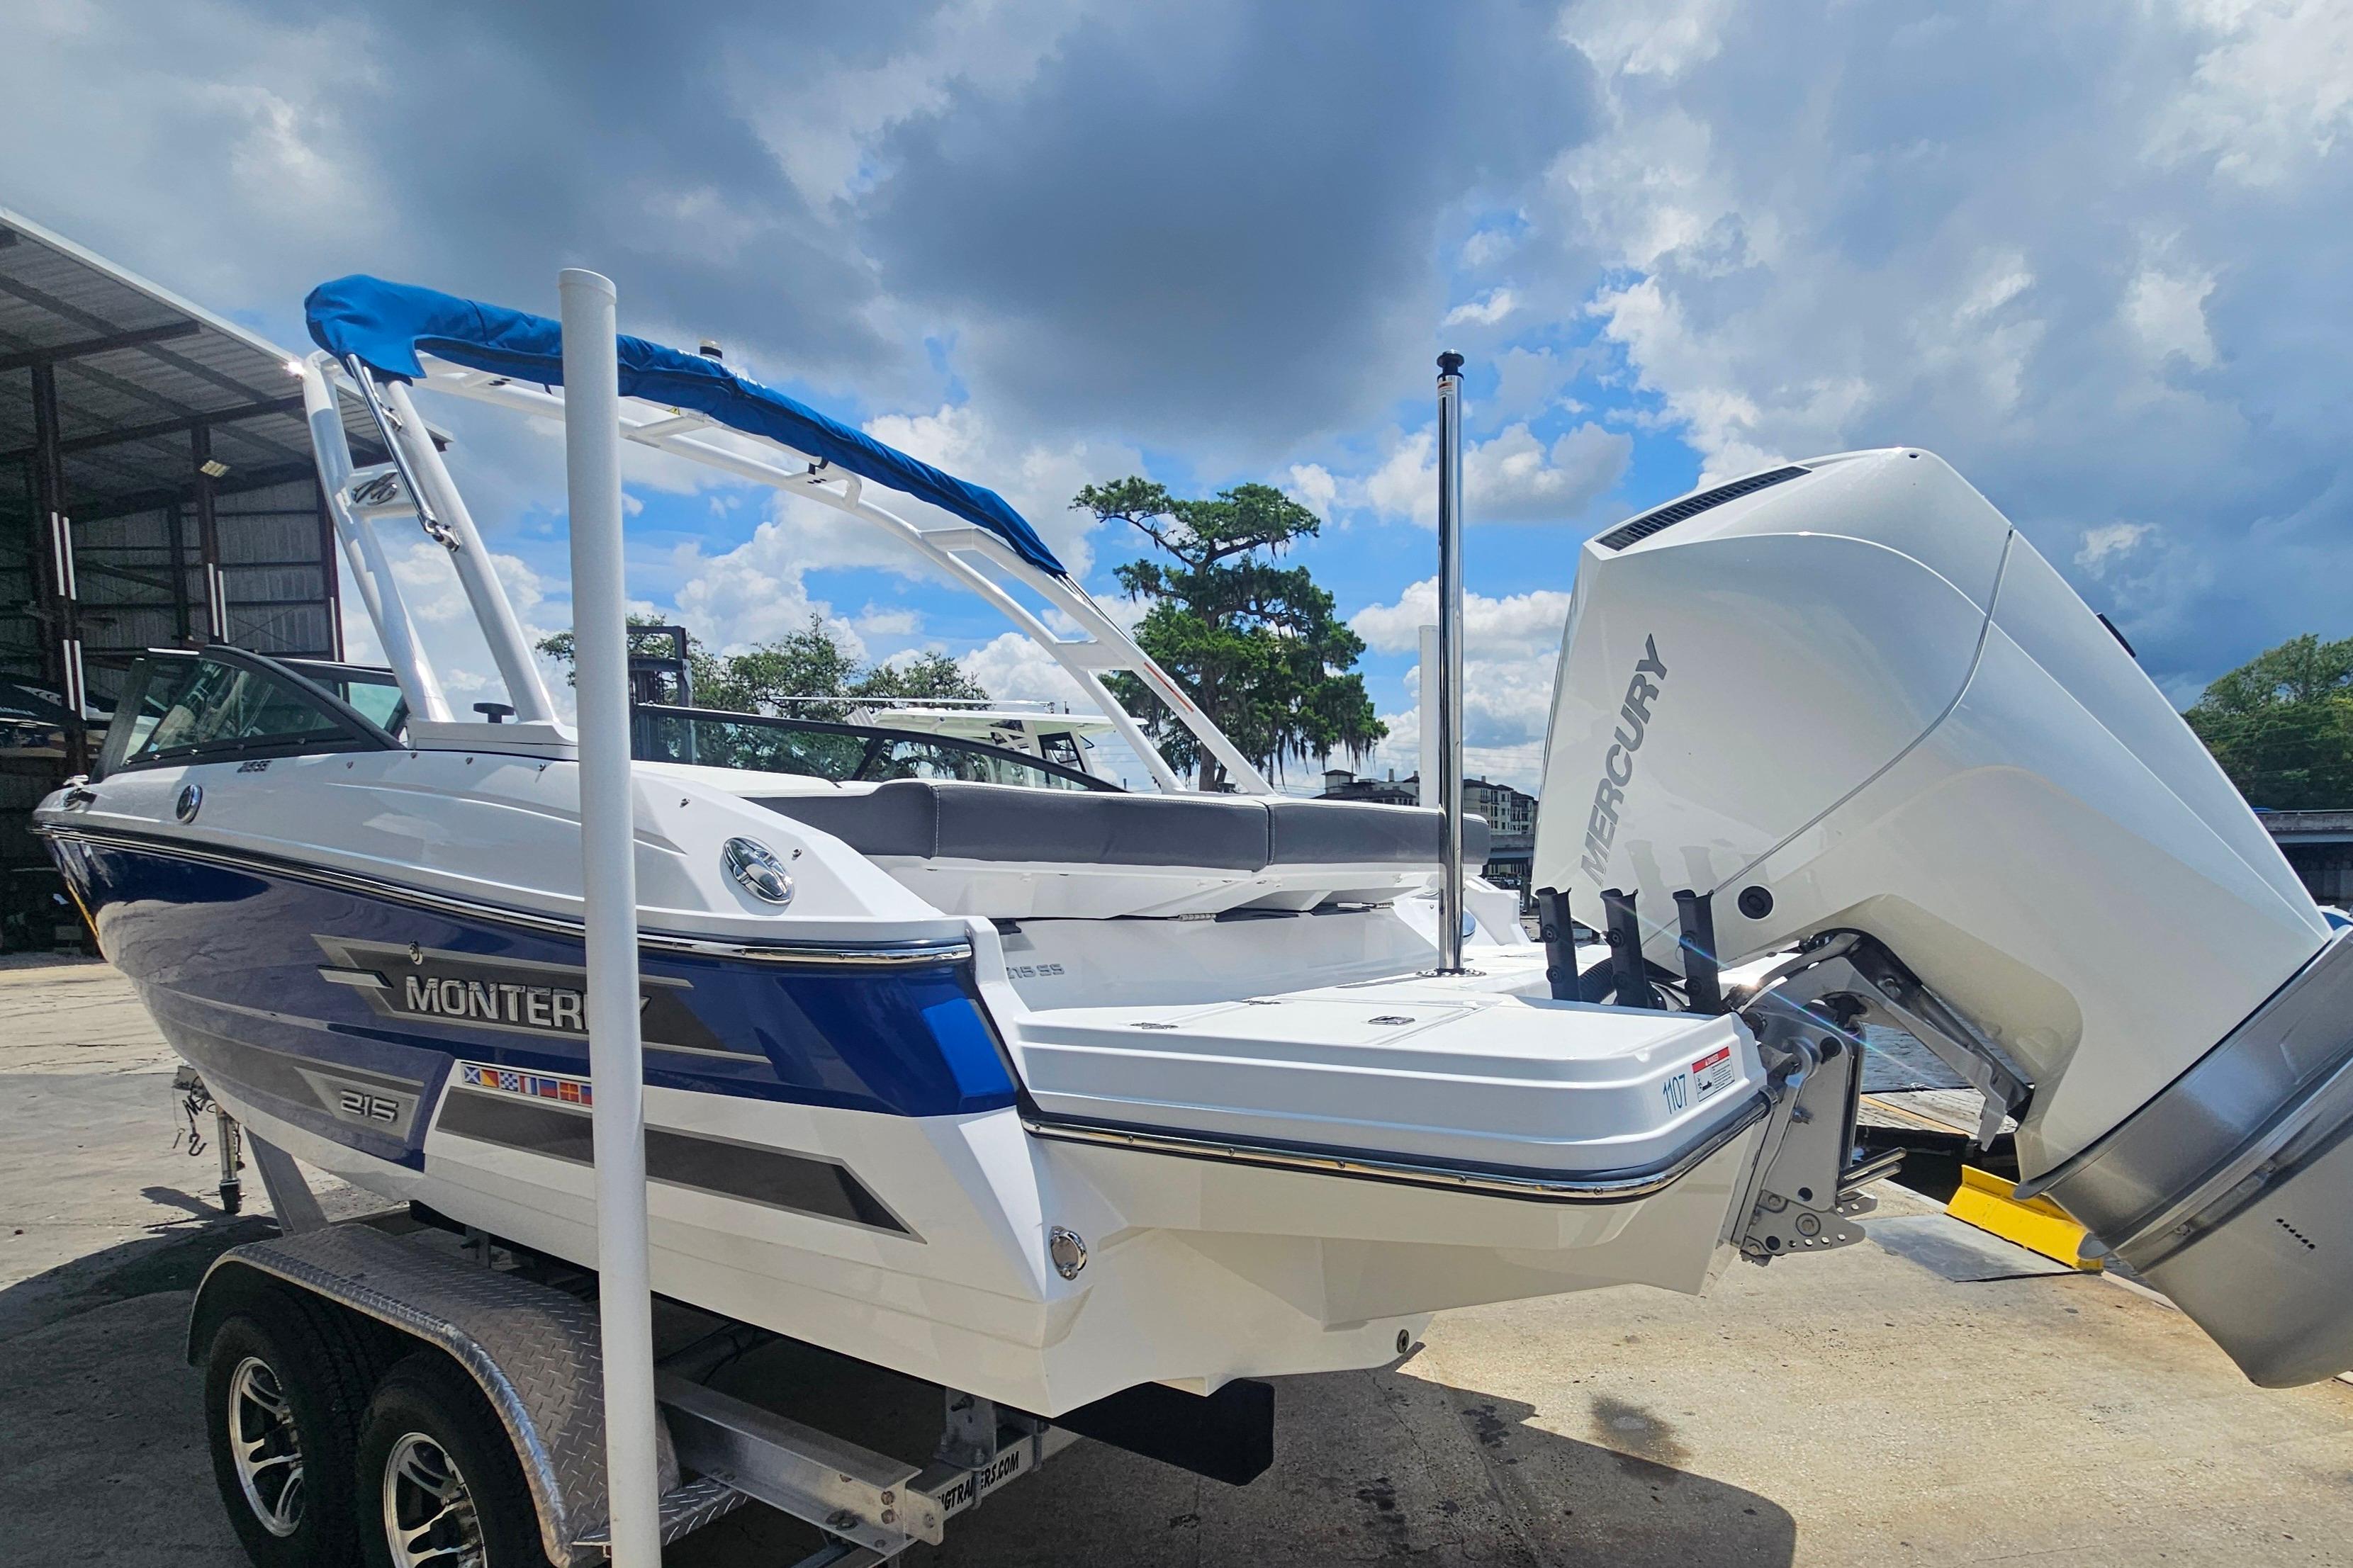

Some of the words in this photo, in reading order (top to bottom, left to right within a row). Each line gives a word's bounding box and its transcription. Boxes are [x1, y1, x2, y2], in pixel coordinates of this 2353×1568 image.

[1581, 633, 1667, 889] MERCURY
[1037, 963, 1065, 976] SS
[405, 975, 650, 1030] MONTER
[340, 1088, 399, 1122] 215
[1663, 1073, 1688, 1115] 1107
